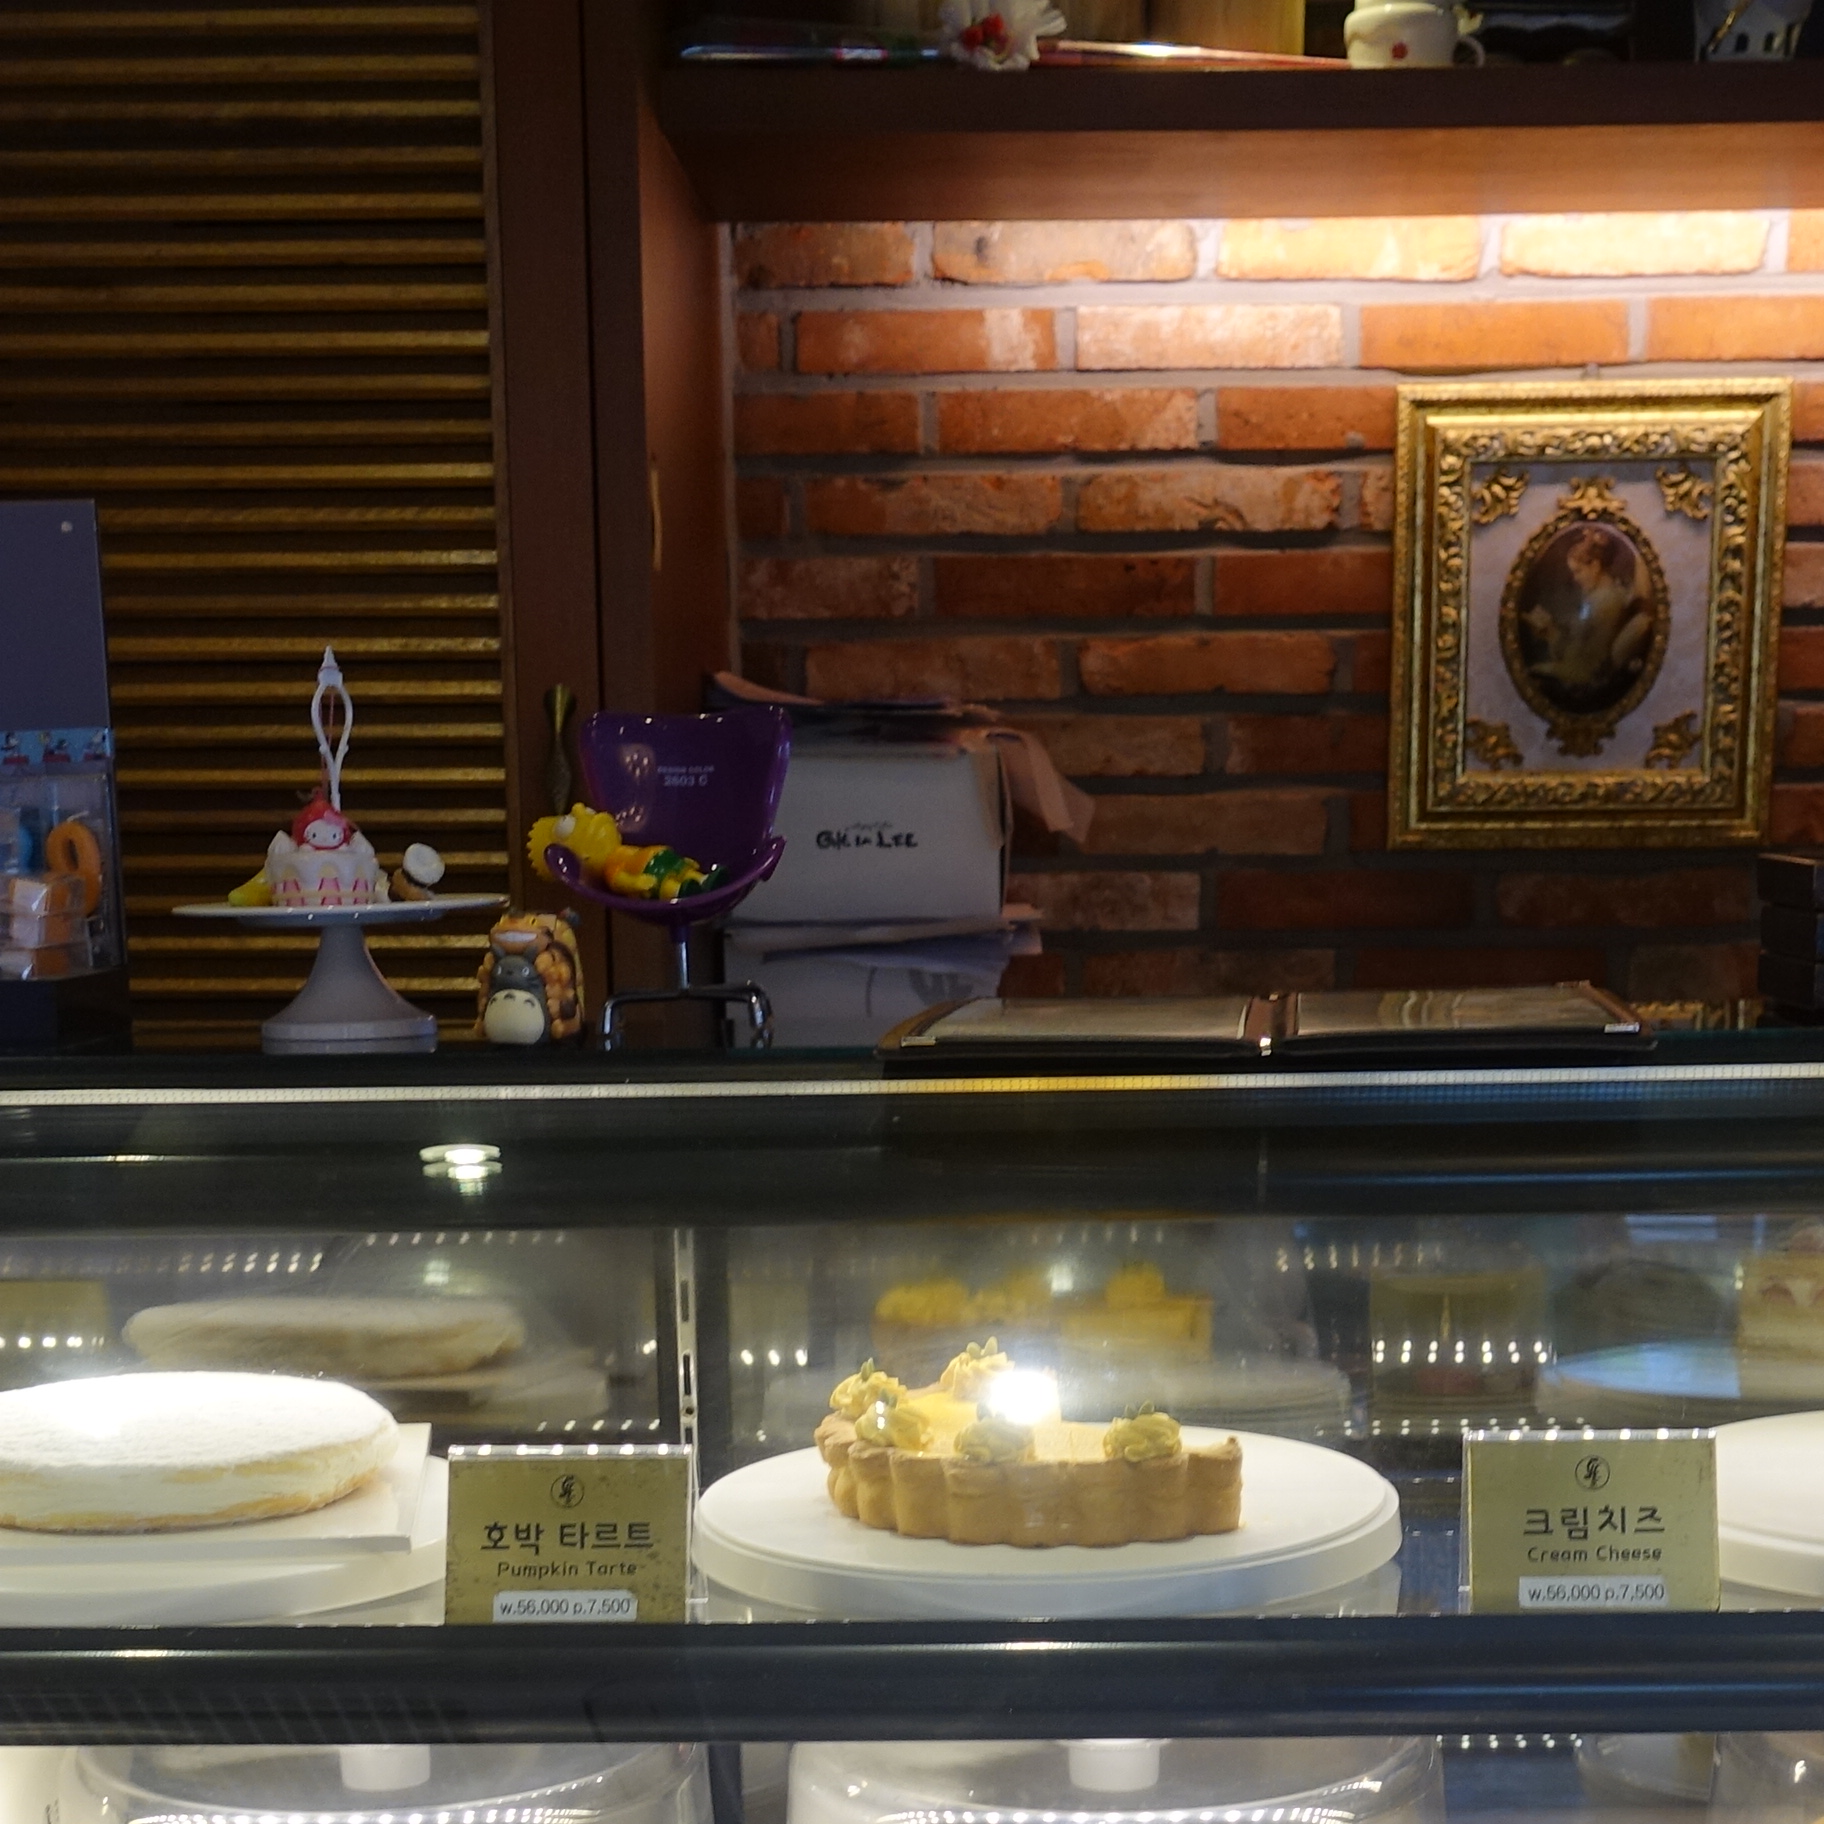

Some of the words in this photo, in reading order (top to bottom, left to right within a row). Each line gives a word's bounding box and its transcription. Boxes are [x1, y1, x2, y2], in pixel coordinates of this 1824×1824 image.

[1523, 1505, 1665, 1541] 크림치즈
[480, 1522, 545, 1556] 호박
[559, 1521, 654, 1549] 타르트
[1527, 1547, 1588, 1563] Cream
[1596, 1546, 1663, 1561] Cheese
[497, 1561, 578, 1580] Pumpkin
[587, 1561, 637, 1576] Tarte
